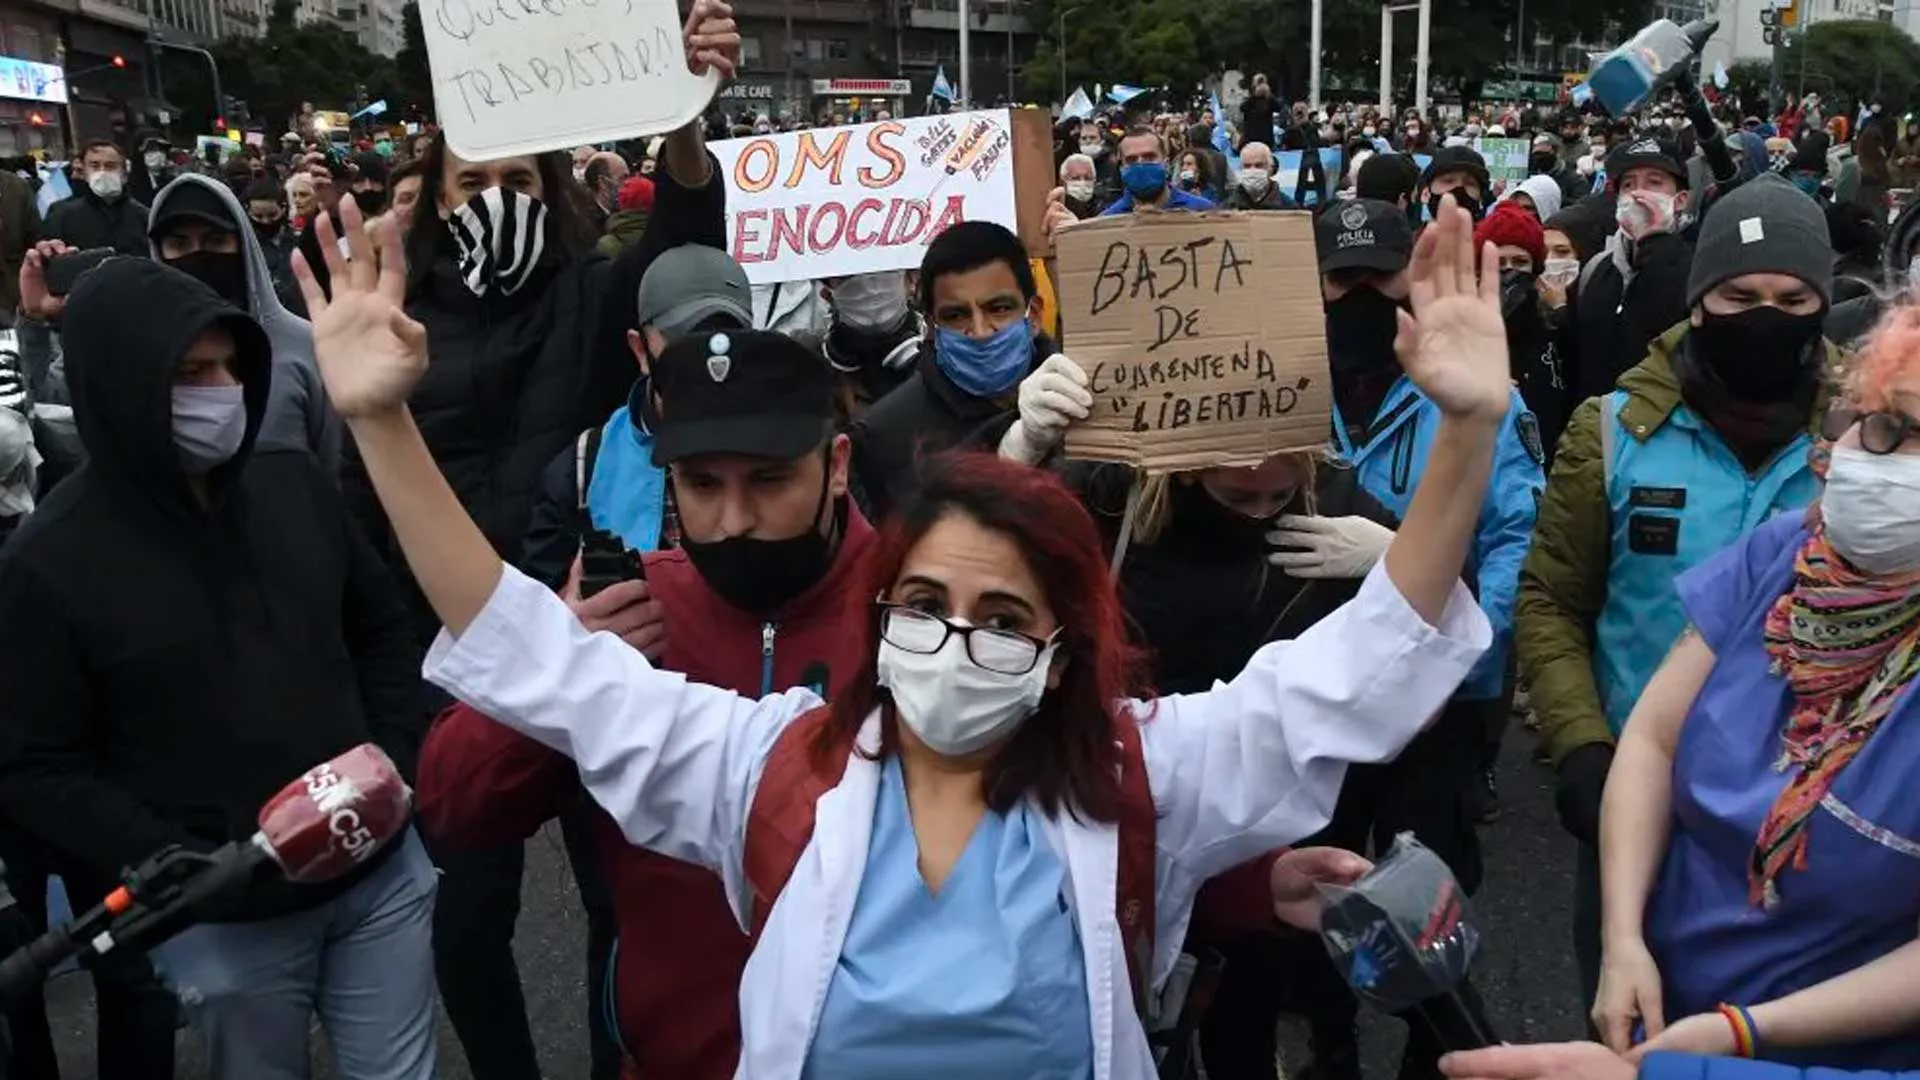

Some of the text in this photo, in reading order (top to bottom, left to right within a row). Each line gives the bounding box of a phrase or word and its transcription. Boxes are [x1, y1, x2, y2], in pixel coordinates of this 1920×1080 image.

[733, 121, 906, 193] OMS
[726, 195, 966, 264] ENOCIDA
[1090, 236, 1252, 316] BASTA
[1146, 304, 1200, 353] DE
[1091, 341, 1276, 394] CUARENTENA
[1112, 377, 1311, 432] "LIBERTAD"
